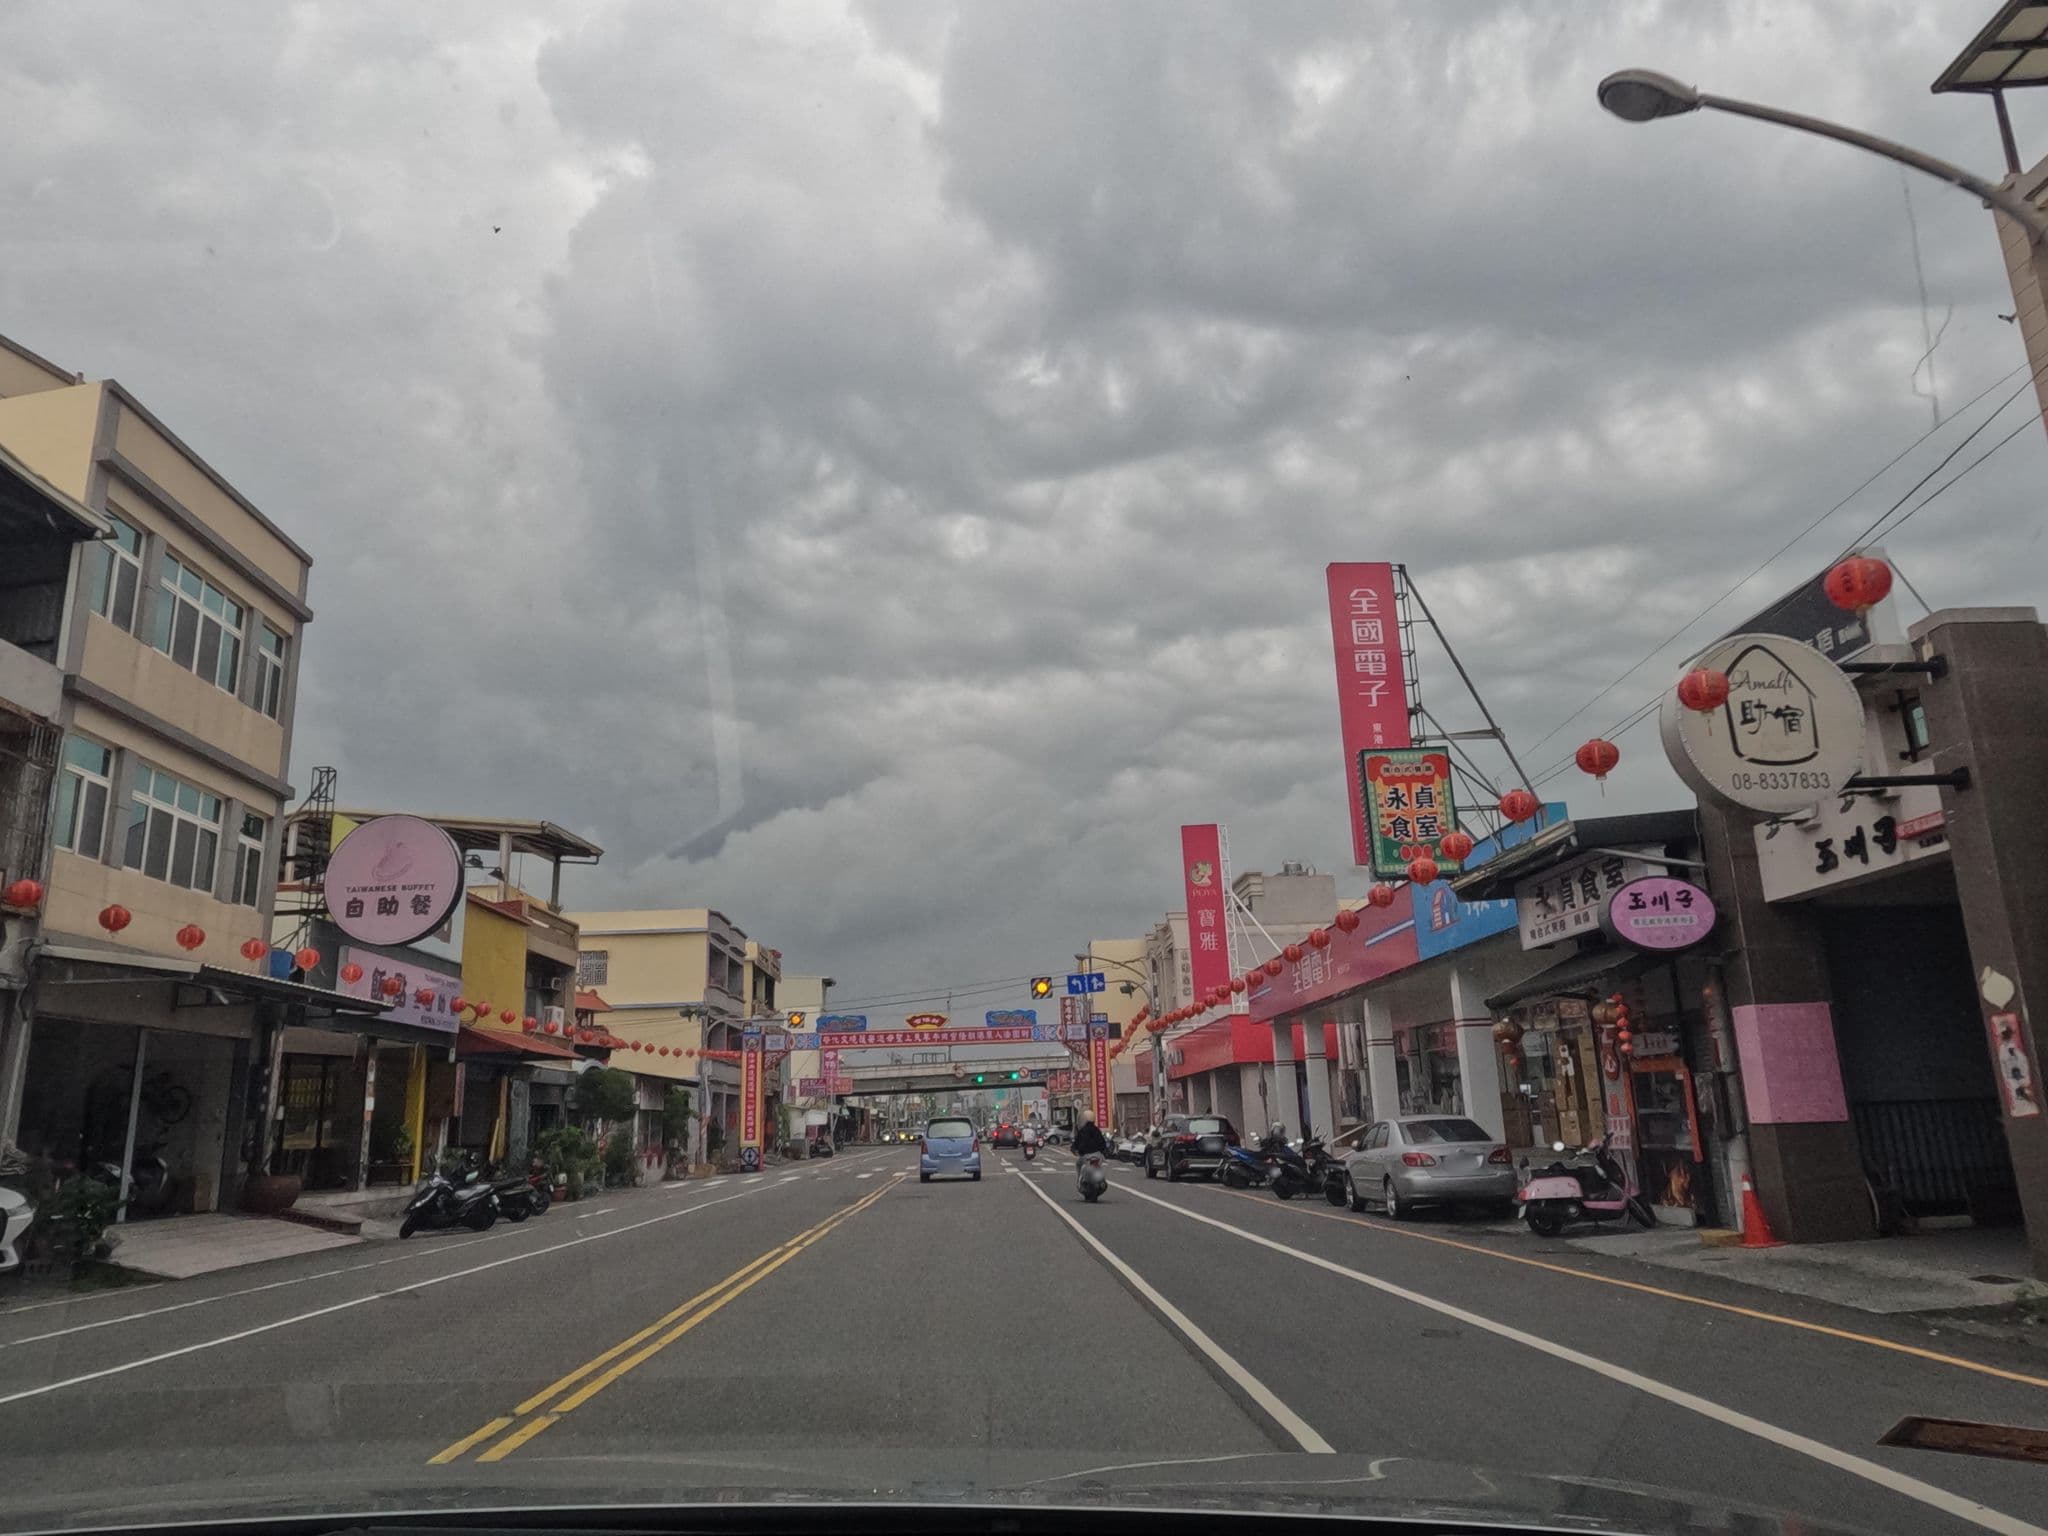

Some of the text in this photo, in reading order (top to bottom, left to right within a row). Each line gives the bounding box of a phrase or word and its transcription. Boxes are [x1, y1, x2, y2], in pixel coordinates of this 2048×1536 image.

[1349, 588, 1391, 708] 全國電子
[1732, 772, 1831, 790] 08-8337833
[1386, 786, 1435, 810] 永貞
[1389, 815, 1441, 839] 食室
[345, 883, 436, 894] TAIWANESE BUFFET
[1627, 889, 1695, 912] 玉川子
[345, 894, 432, 919] 自助餐
